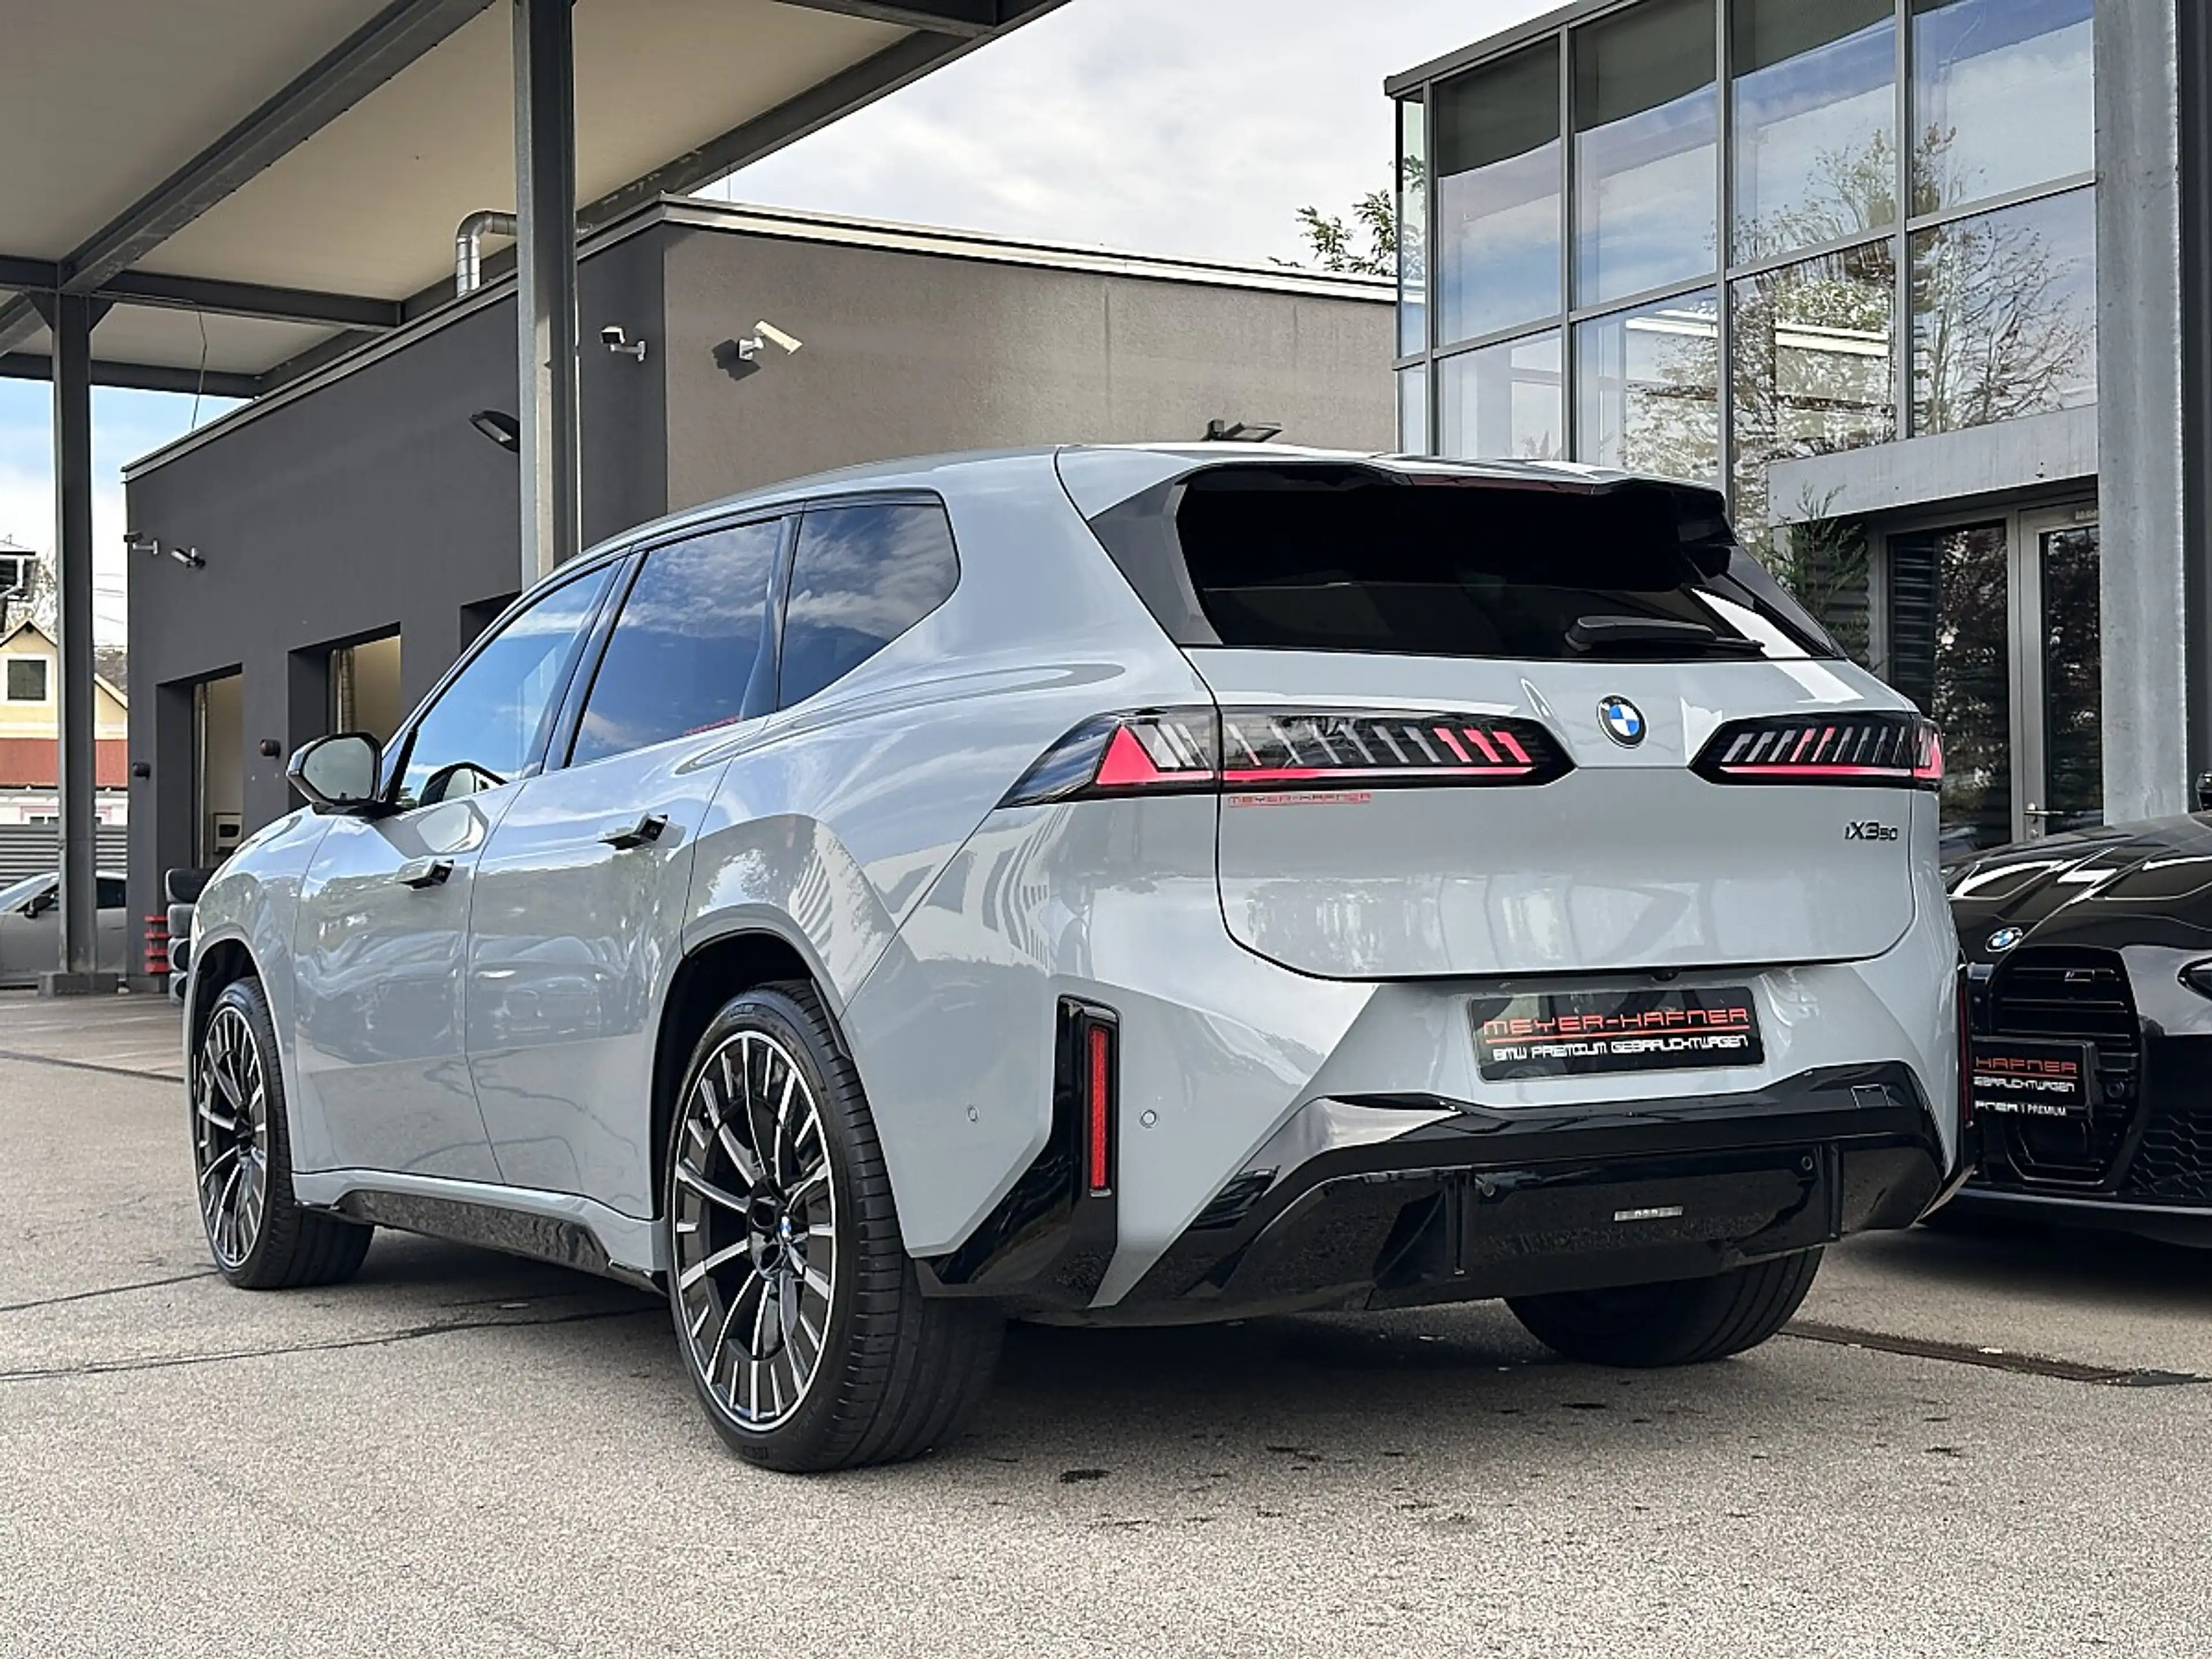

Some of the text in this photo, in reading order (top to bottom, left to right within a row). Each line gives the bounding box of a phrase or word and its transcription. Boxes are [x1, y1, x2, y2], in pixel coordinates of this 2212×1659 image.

[1483, 1007, 1749, 1035] MEYER-HAFNER
[1493, 1035, 1748, 1061] BMW PREMIUM GEBRAUCHTWAGEN
[1976, 1056, 2077, 1074] HAFNER
[1975, 1100, 2017, 1113] FNER
